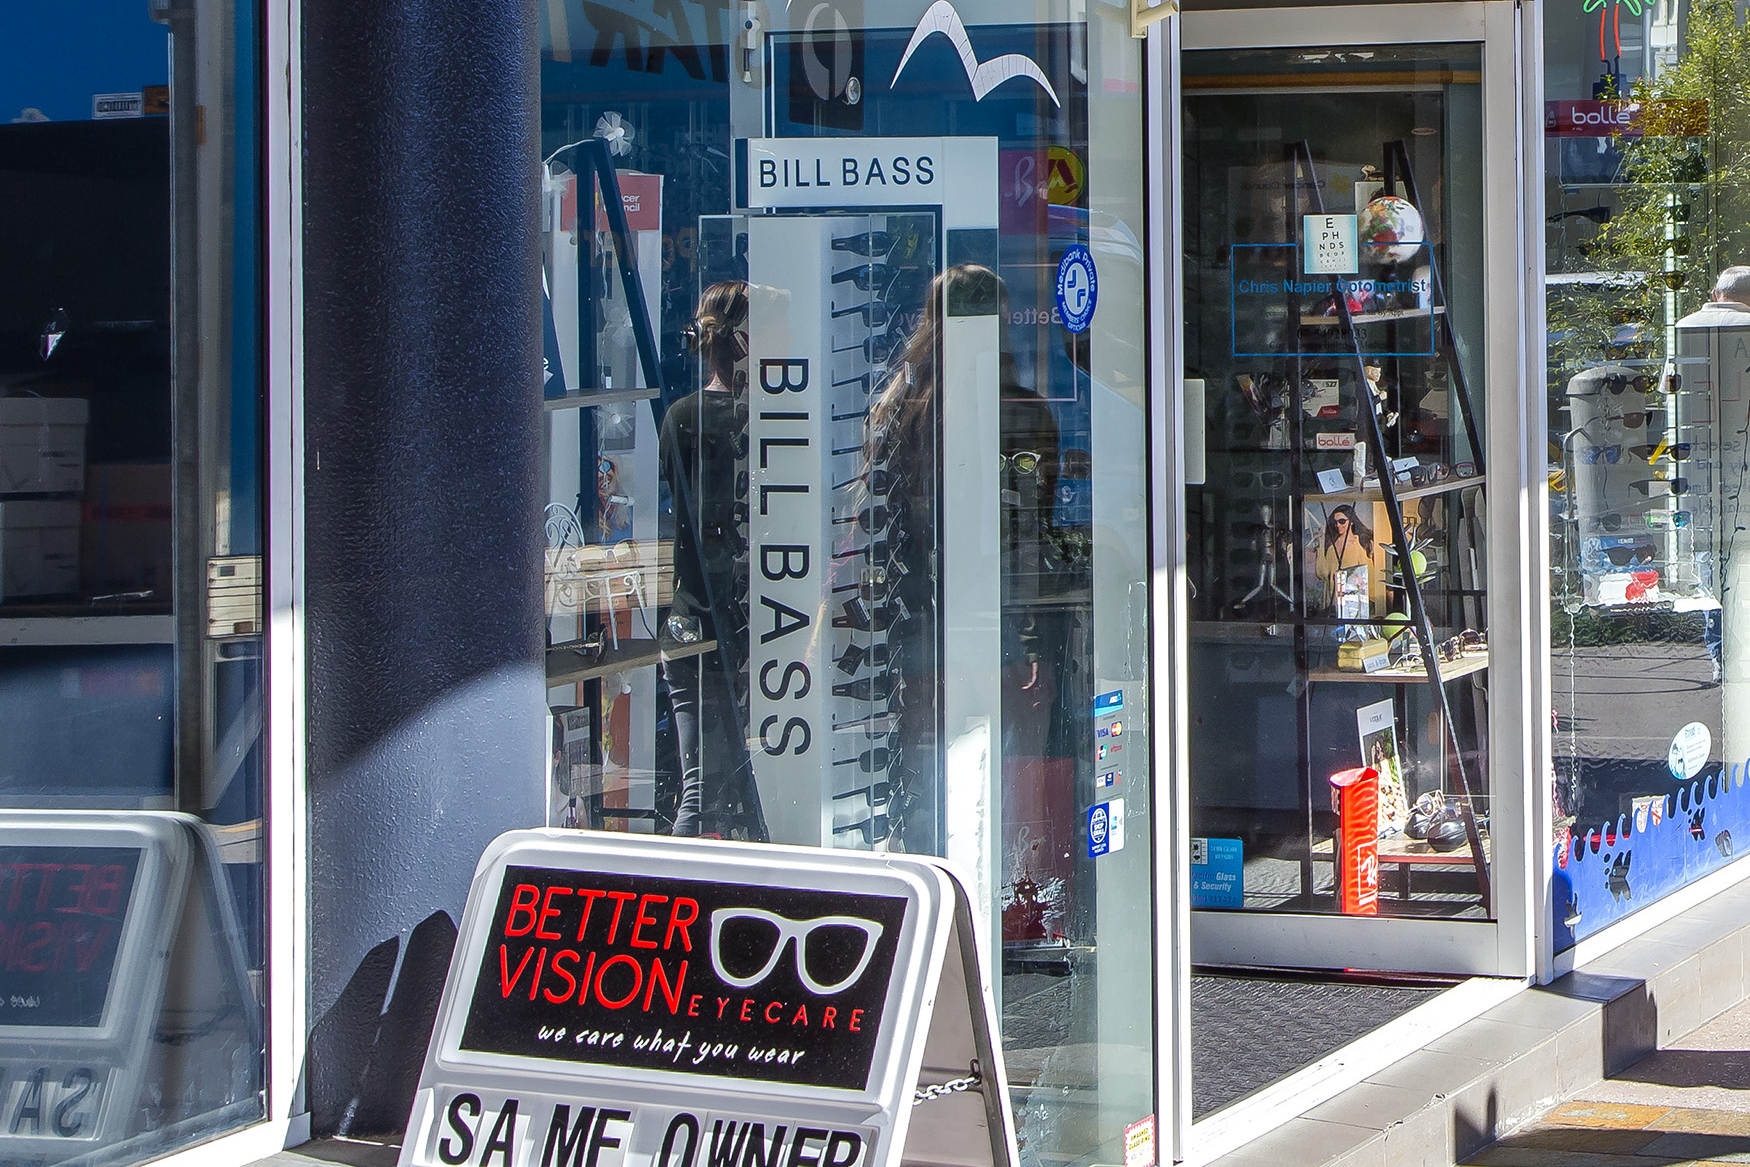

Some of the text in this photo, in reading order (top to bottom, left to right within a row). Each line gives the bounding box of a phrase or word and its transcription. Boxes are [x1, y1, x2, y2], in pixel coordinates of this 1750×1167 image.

[760, 156, 934, 187] BILL BASS
[1057, 248, 1096, 295] Medibank Private
[1239, 278, 1426, 295] Chris Napier Optometrist
[759, 358, 811, 756] BILL BASS
[1201, 881, 1232, 893] Security
[1216, 871, 1237, 881] Glass
[504, 883, 699, 952] BETTER
[499, 944, 689, 1015] VISION
[688, 994, 866, 1033] EYECARE
[537, 1025, 805, 1065] we care what you wear
